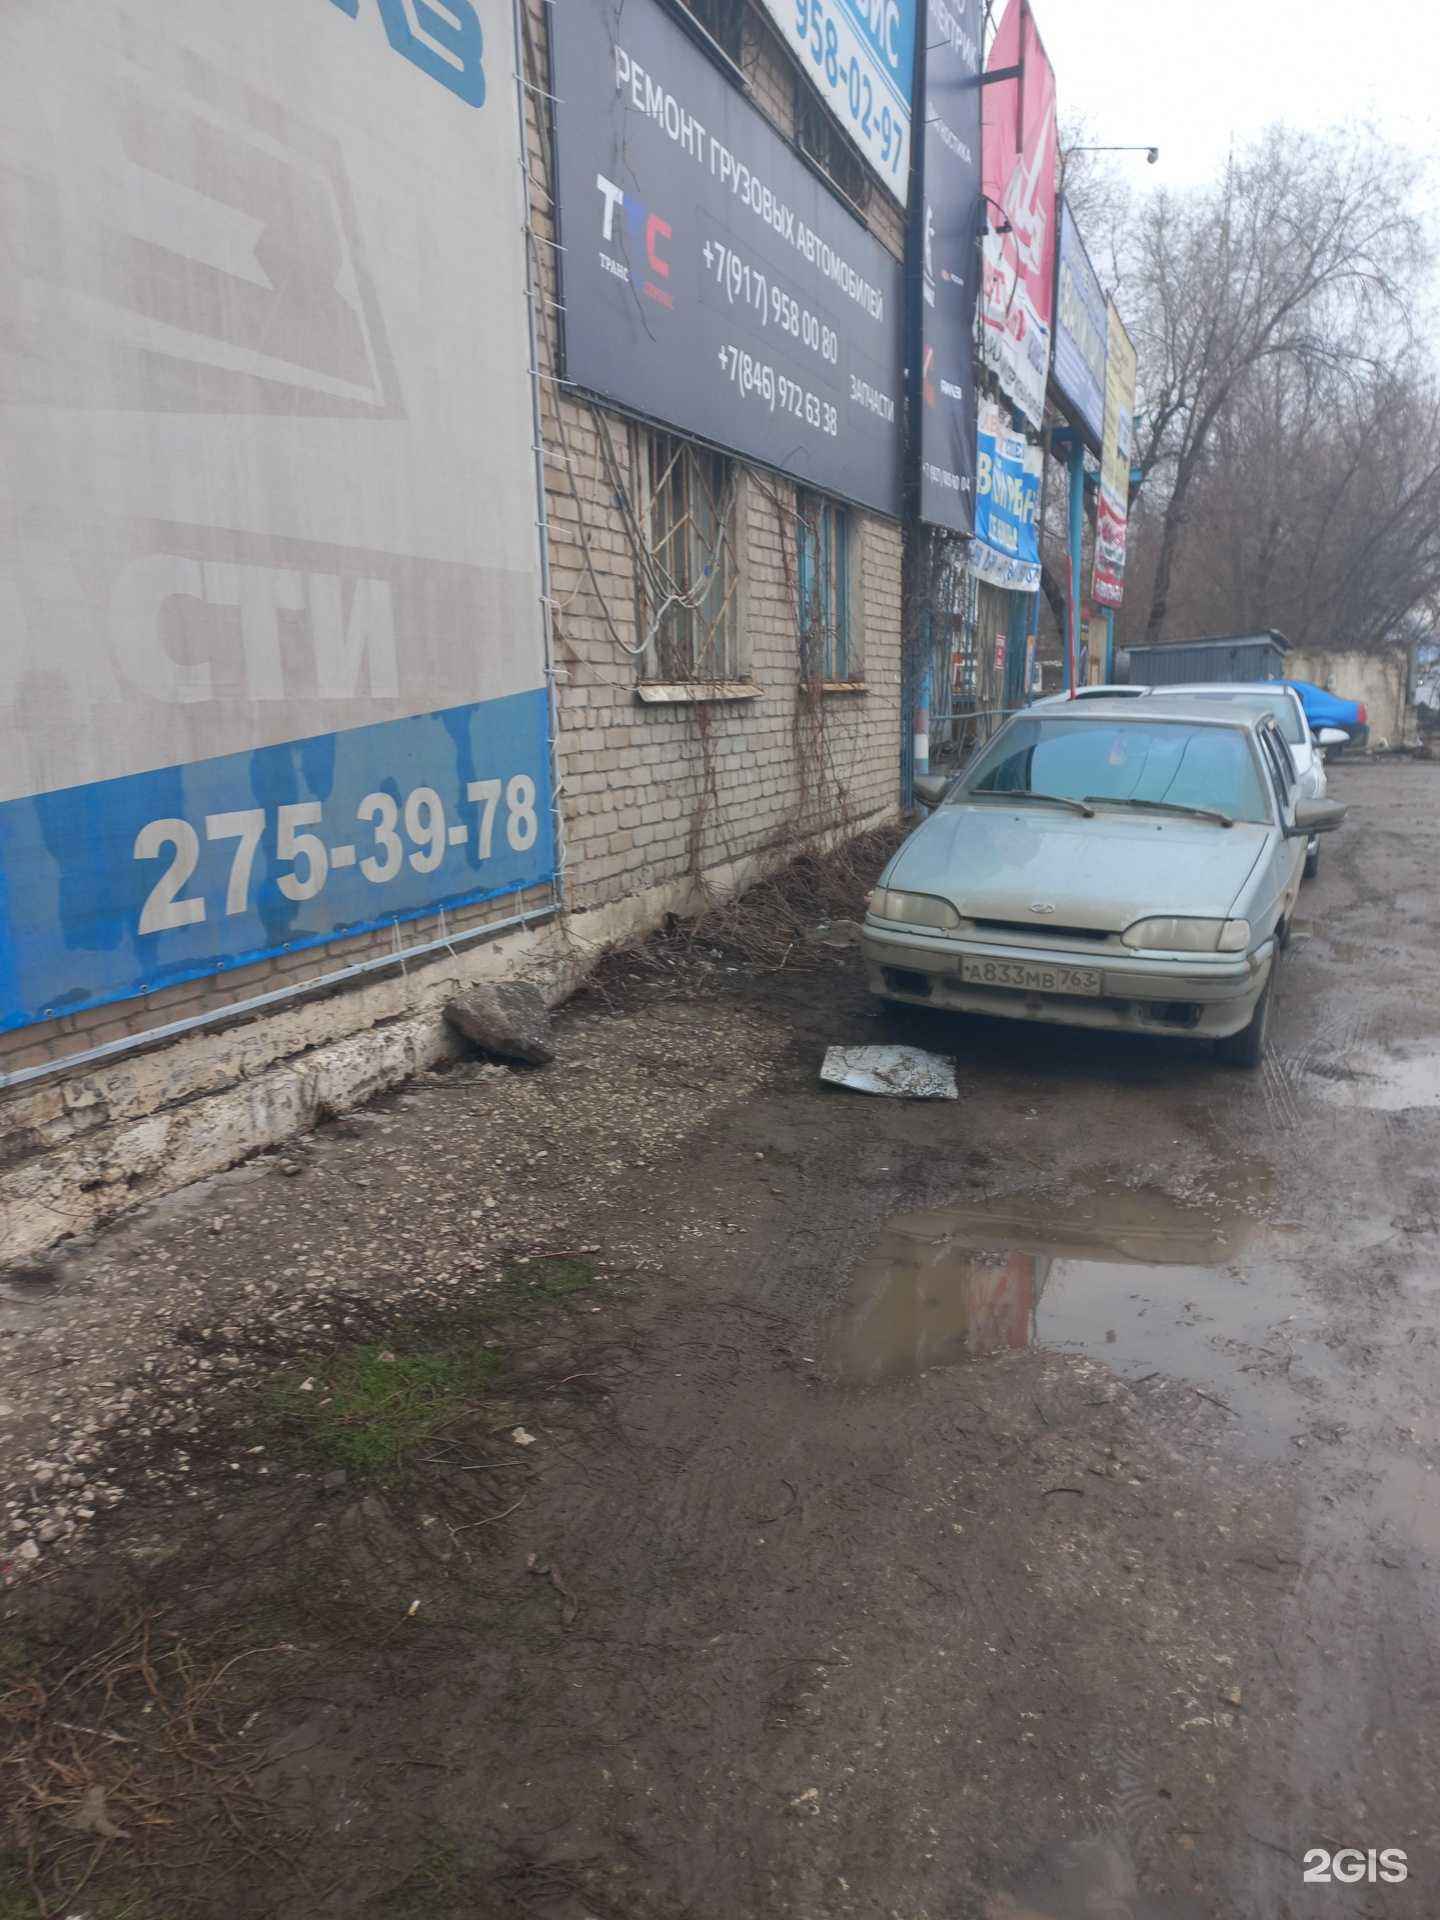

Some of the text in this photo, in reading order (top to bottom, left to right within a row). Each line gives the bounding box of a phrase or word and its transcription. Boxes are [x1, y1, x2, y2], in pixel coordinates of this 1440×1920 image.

[796, 0, 904, 174] 958-02-97
[849, 0, 901, 68] ИС
[614, 44, 706, 162] РЕМОНТ
[710, 137, 796, 245] ГРУЗОВЫХ
[797, 221, 884, 322] АВТОМОБИЛЕЙ
[702, 239, 768, 327] +7(917)
[771, 285, 800, 337] 958
[802, 309, 820, 352] 00
[821, 325, 838, 364] 80
[718, 344, 838, 436] +7(846) 972 63 38
[849, 373, 895, 424] ЗАПЧАСТИ
[0, 545, 398, 706] АСТИ
[132, 773, 538, 936] 275-39-78
[968, 962, 1099, 989] А833МВ 763
